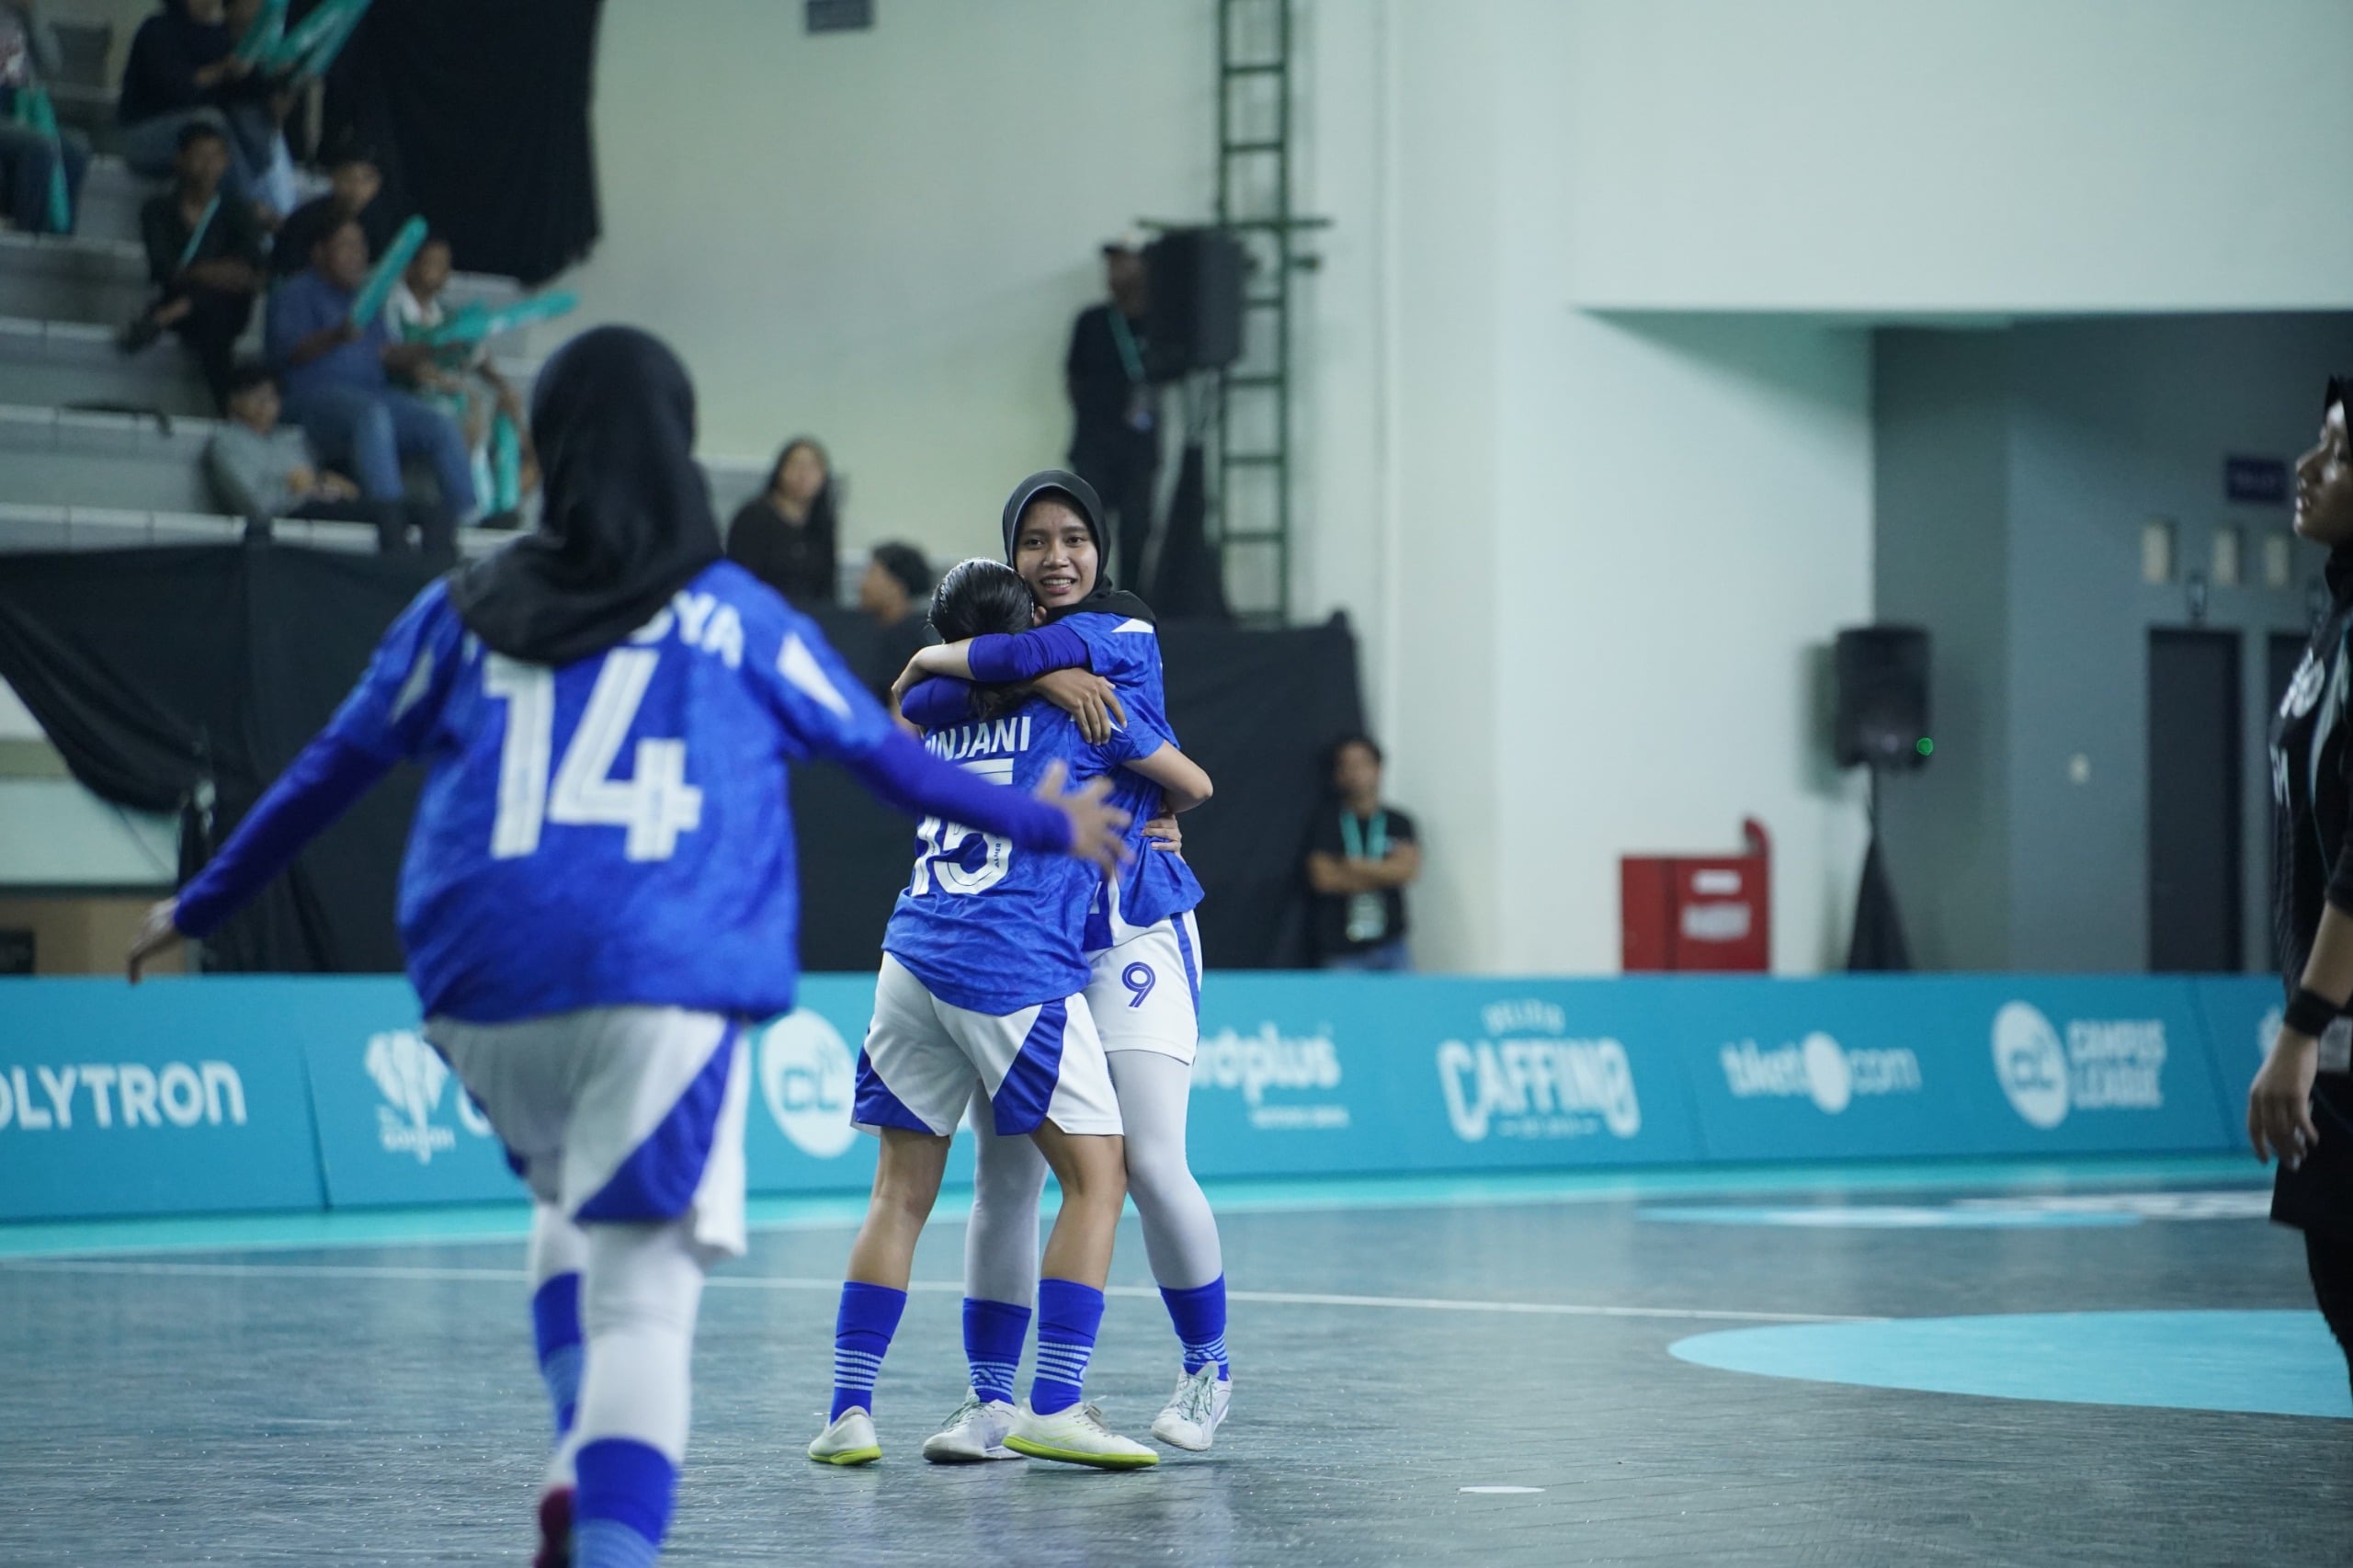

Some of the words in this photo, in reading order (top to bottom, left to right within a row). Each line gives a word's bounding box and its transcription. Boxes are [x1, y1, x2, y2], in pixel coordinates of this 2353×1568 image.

[483, 647, 703, 861] 14
[1121, 961, 1156, 1008] 9
[1437, 1038, 1641, 1142] CAFFINO
